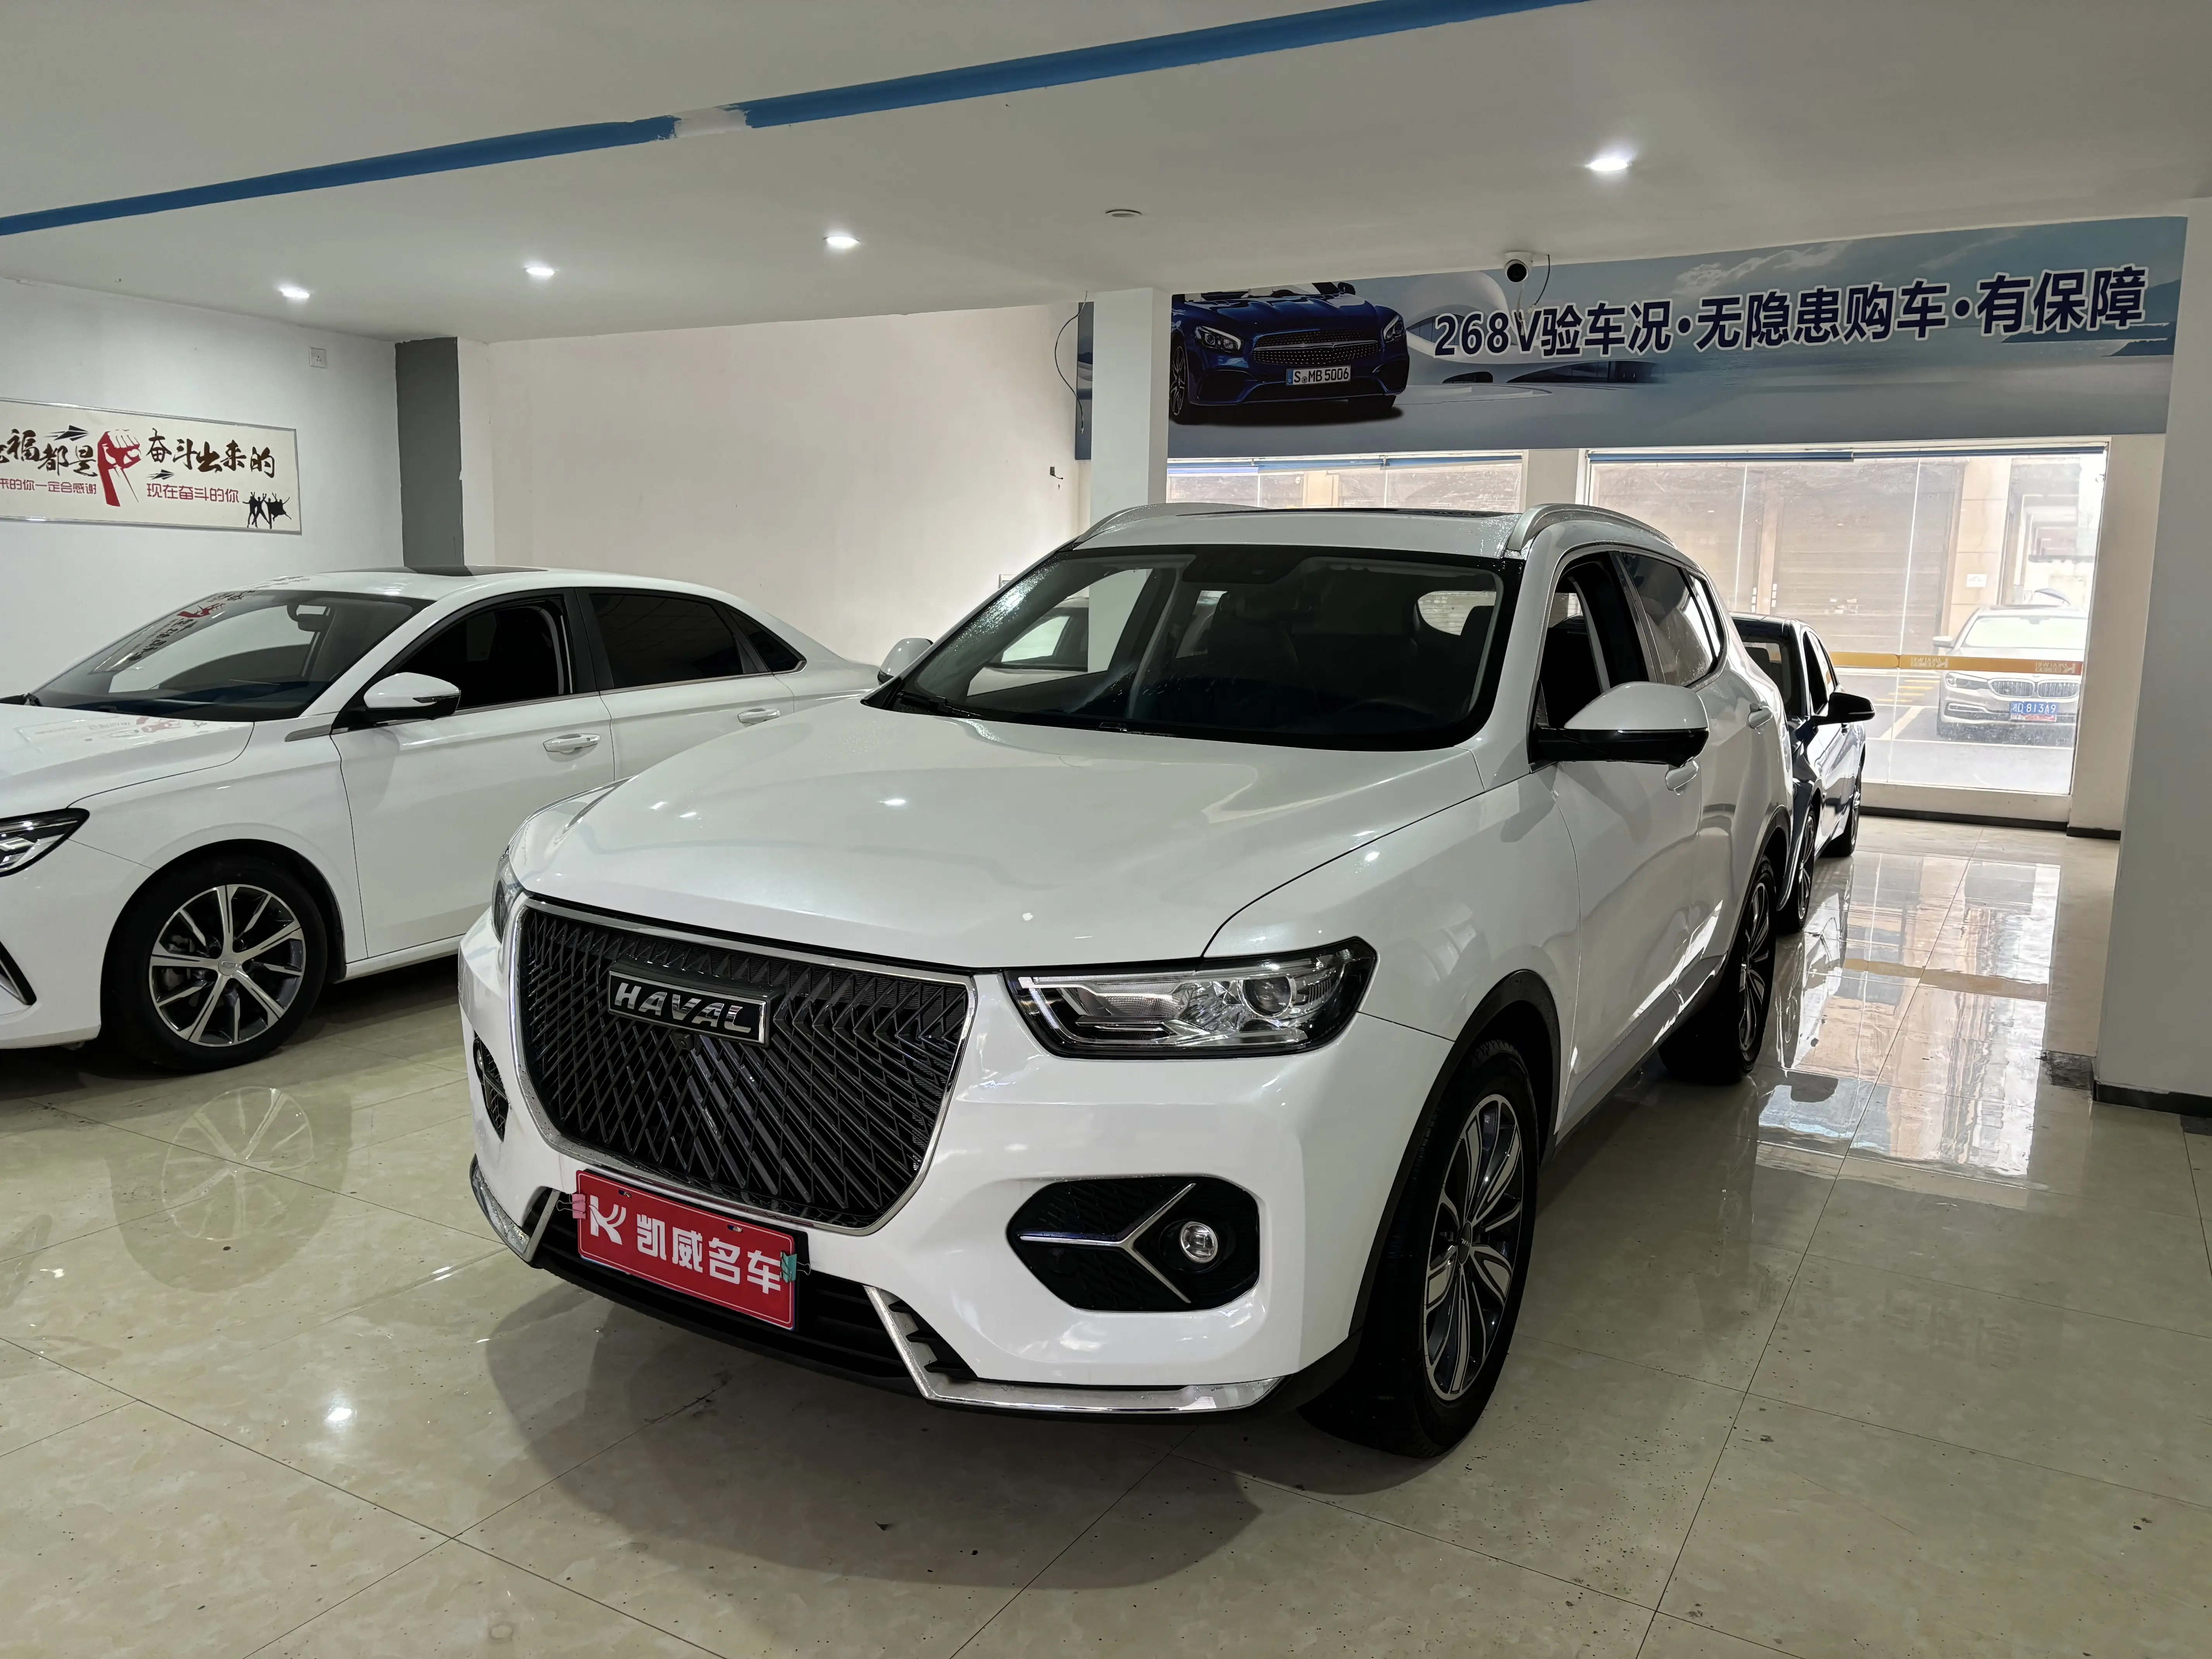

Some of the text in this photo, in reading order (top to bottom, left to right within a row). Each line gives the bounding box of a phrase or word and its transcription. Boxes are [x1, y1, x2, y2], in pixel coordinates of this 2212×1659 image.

[1294, 368, 1349, 383] S MB 5006
[146, 428, 275, 478] 奋斗出来的
[146, 483, 239, 503] 现在奋斗的你
[614, 982, 750, 1033] HAVAL
[637, 1214, 781, 1294] 凯威名车
